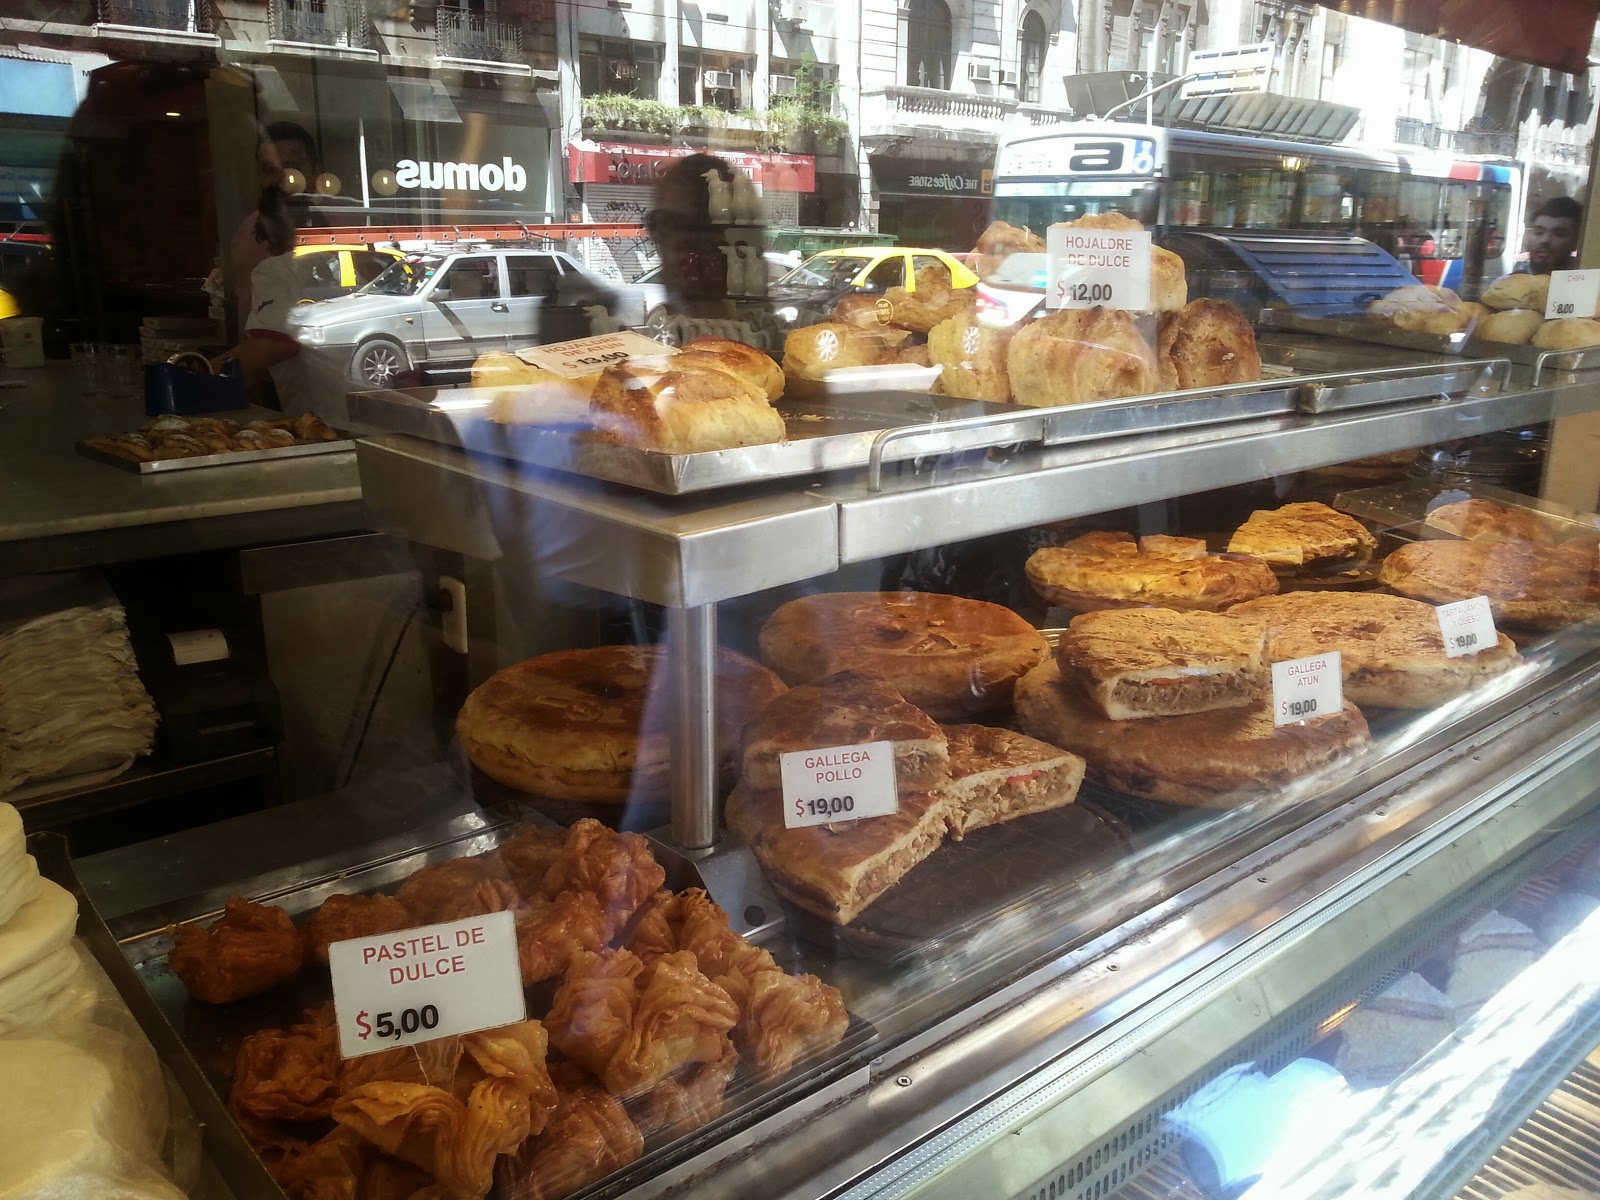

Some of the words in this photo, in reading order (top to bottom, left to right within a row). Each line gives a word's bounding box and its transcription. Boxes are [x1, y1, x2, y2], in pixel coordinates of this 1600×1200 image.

[1065, 236, 1133, 251] HOJALDRE
[1068, 253, 1085, 266] DE
[1089, 255, 1130, 267] DULCE
[543, 336, 623, 355] HOJALDRE
[562, 349, 586, 357] DE
[588, 341, 626, 353] ATUN
[1287, 660, 1327, 676] GALLEGA
[1297, 675, 1319, 688] ATUN
[804, 750, 871, 769] GALLEGA
[816, 767, 862, 784] POLLO
[362, 934, 450, 965] PASTEL
[455, 926, 486, 948] DE
[389, 955, 466, 985] DULCE
